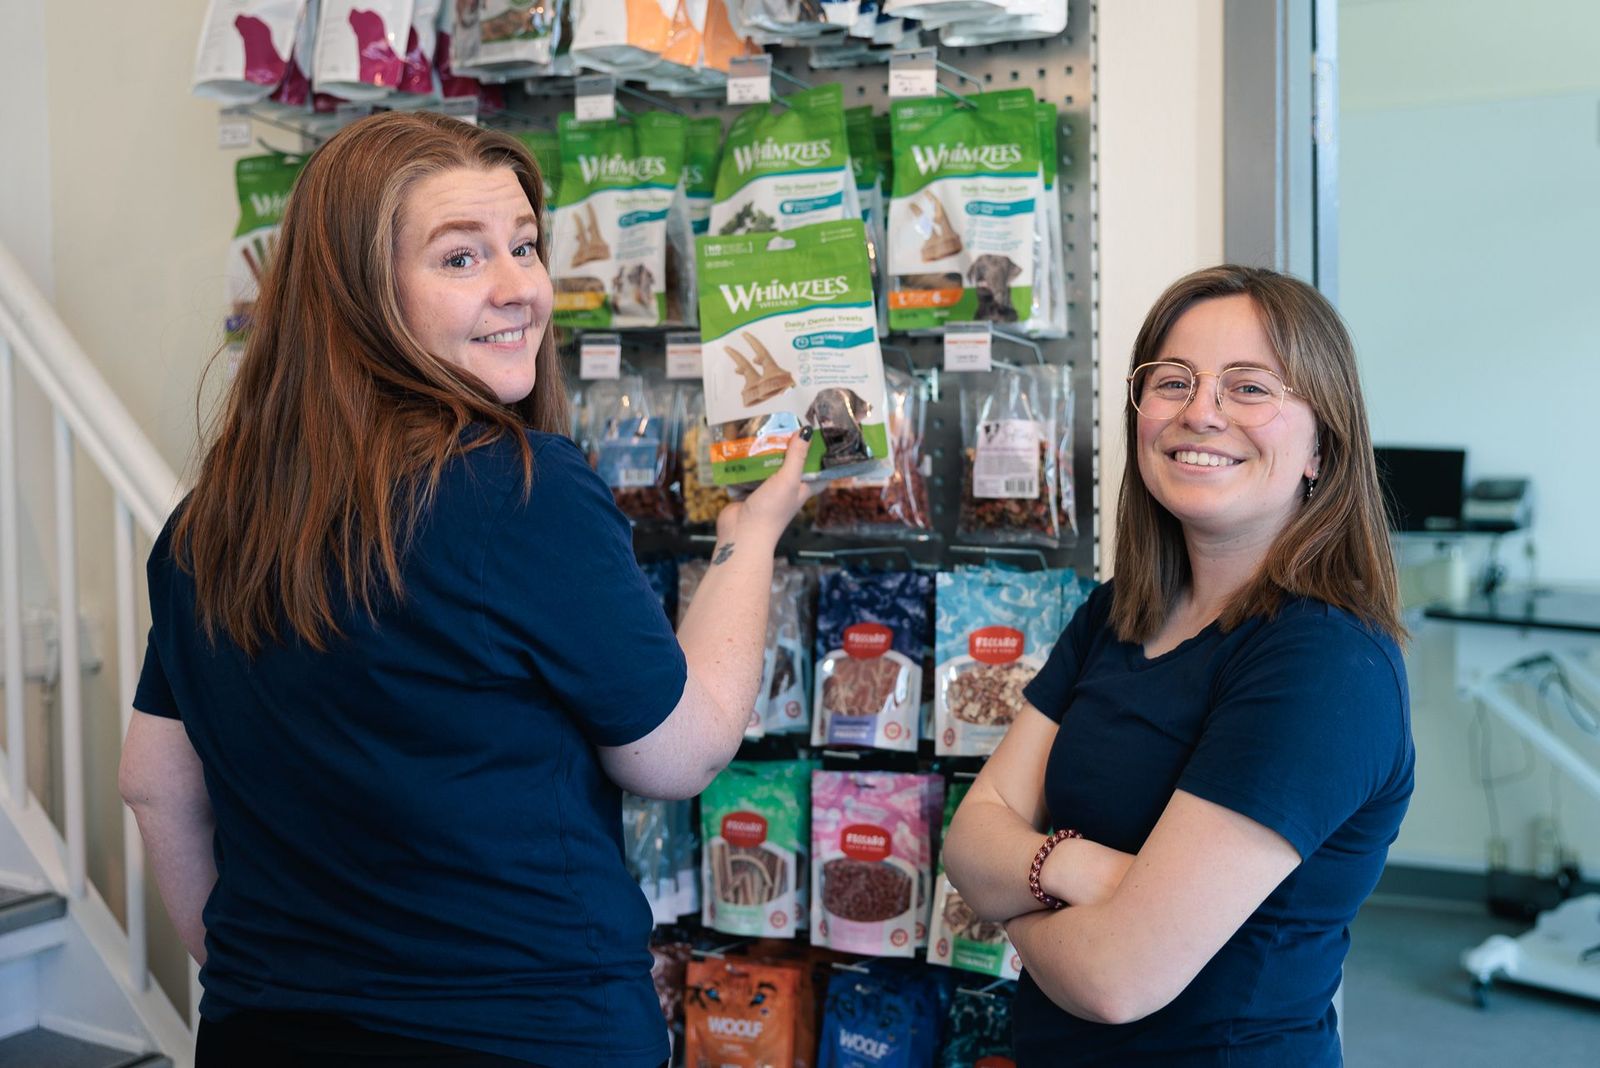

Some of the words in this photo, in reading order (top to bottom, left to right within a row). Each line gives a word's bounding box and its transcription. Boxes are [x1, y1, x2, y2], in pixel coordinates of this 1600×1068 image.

[733, 136, 832, 175] WHIMZEES
[911, 142, 1022, 176] WHIMZEES
[719, 275, 850, 314] WHIMZEES
[784, 320, 805, 330] Daily
[807, 316, 835, 325] Dental
[838, 315, 863, 323] Treats
[707, 1015, 763, 1038] WOOLF
[840, 1028, 889, 1059] WOOLF
